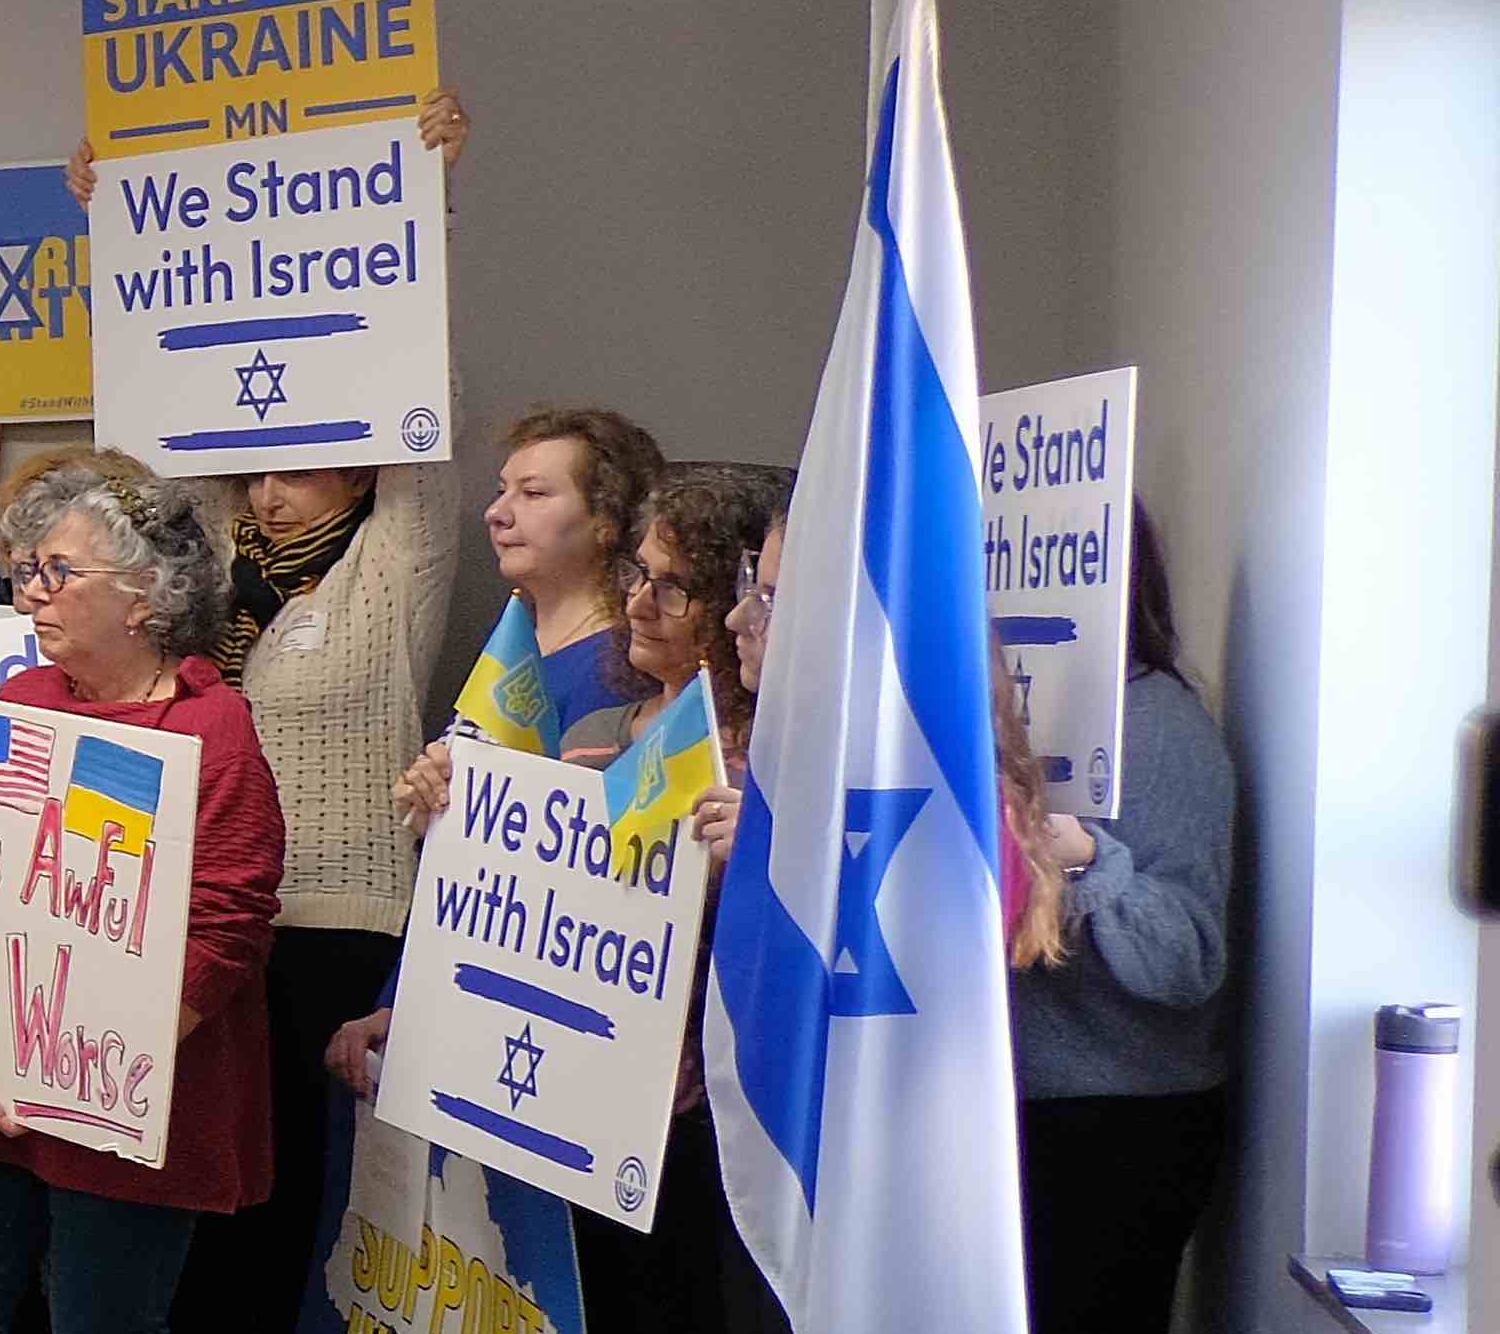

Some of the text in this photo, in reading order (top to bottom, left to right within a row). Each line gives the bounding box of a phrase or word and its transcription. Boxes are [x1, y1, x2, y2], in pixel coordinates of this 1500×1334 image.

[224, 98, 289, 137] MN
[121, 141, 402, 234] We Stand
[115, 243, 234, 312] with
[251, 220, 417, 300] Israel
[983, 399, 1108, 493] e Stand
[985, 503, 1110, 591] th Israel
[464, 766, 528, 852] We
[436, 867, 674, 1001] with Israel
[5, 932, 154, 1118] Worse
